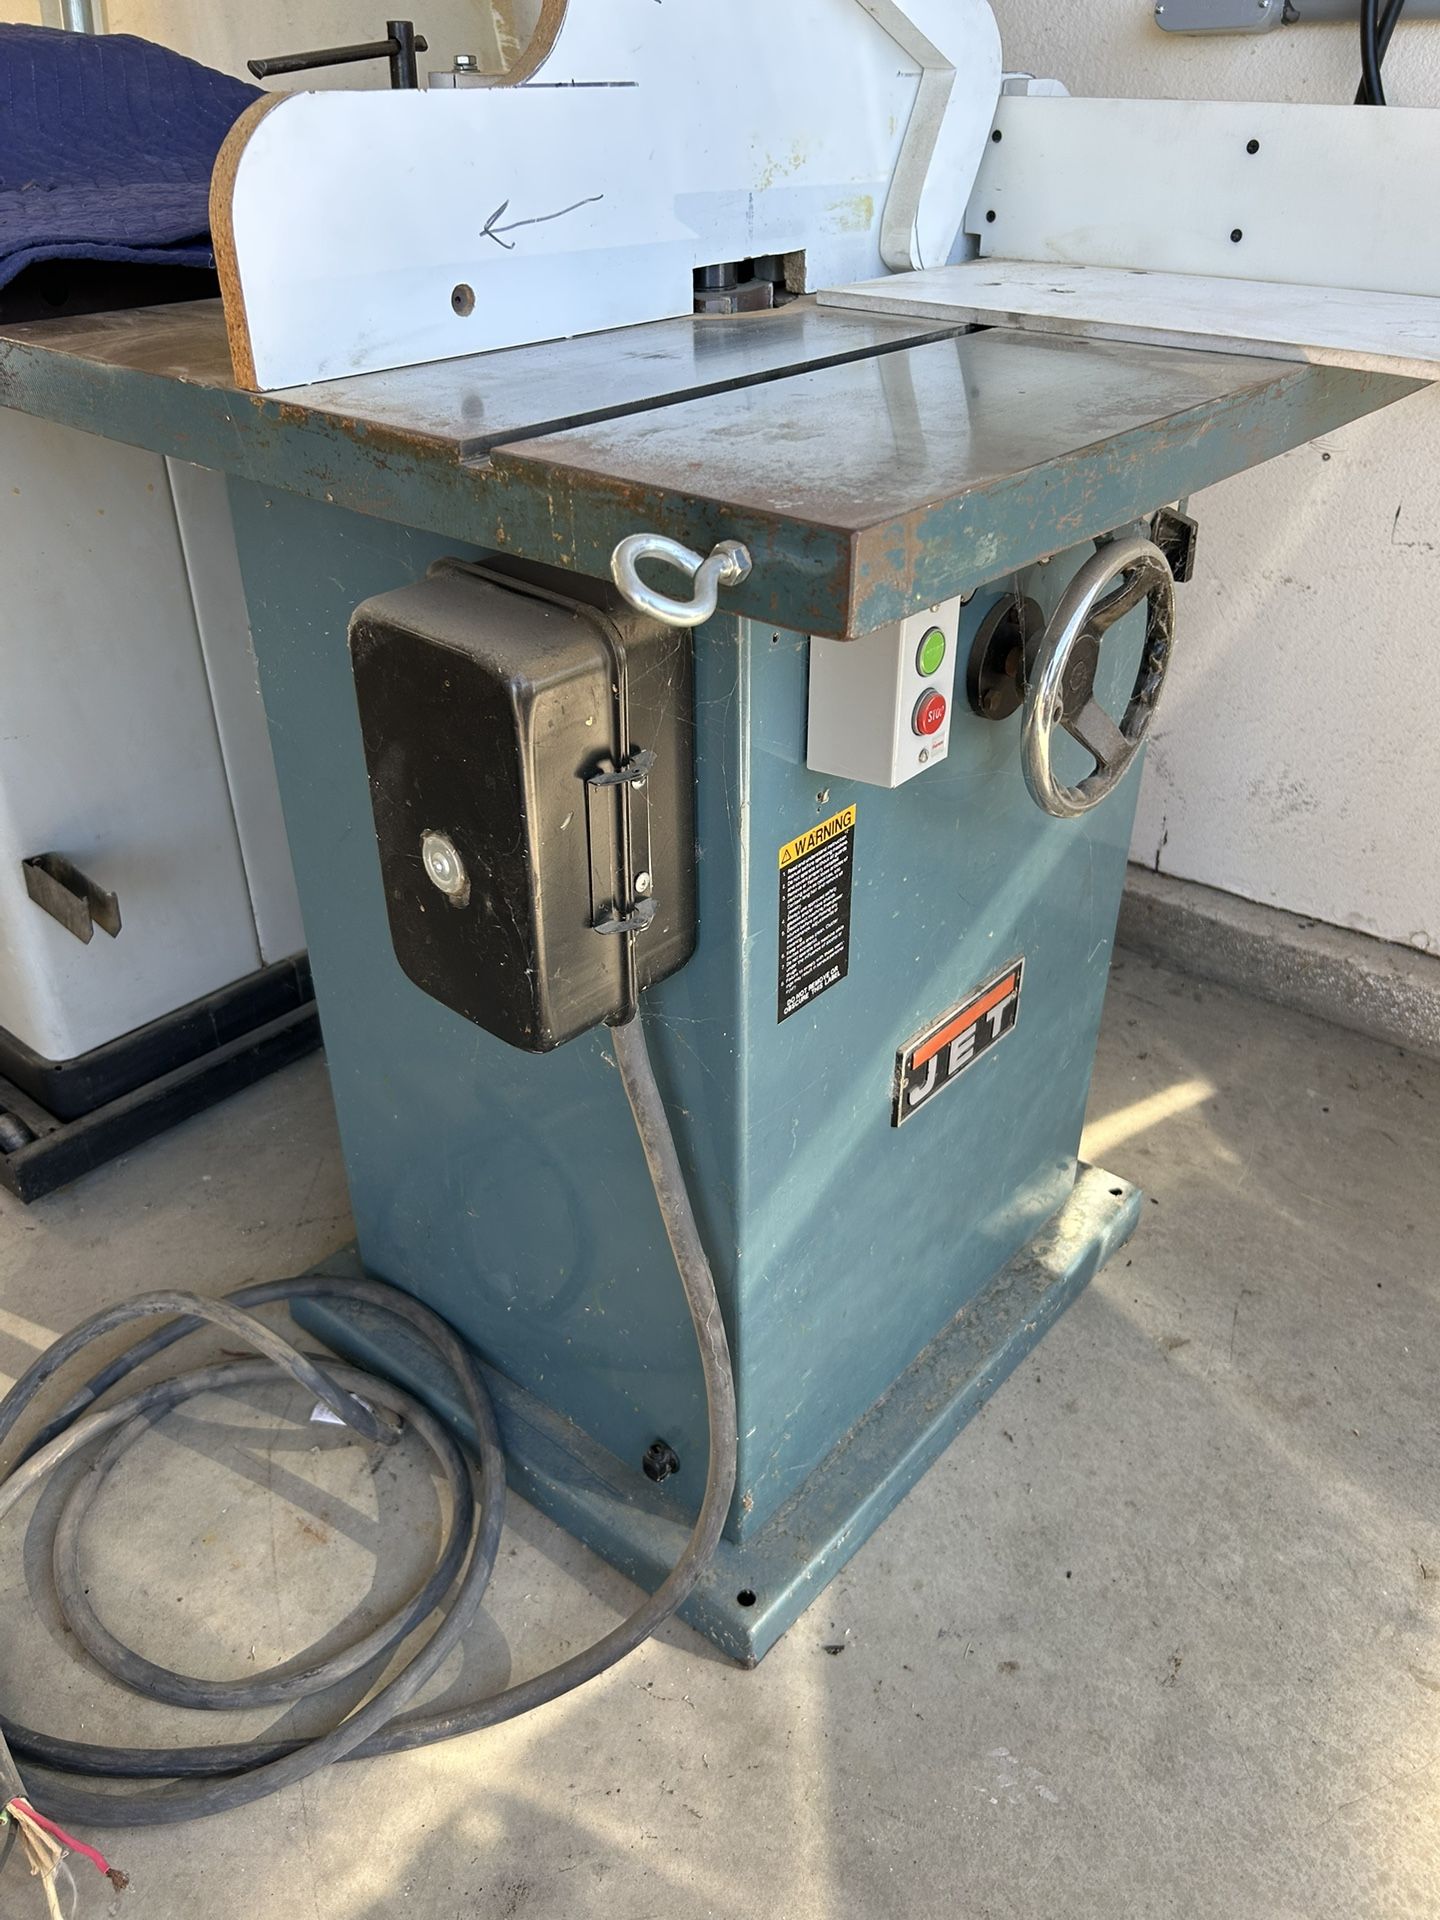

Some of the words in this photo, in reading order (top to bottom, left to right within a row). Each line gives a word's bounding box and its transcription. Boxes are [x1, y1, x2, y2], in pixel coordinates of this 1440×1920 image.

[795, 811, 851, 856] WARNING
[783, 994, 808, 1015] OBSCURE
[811, 983, 823, 995] THIS
[824, 971, 840, 986] LABEL
[786, 996, 795, 1006] DO
[795, 987, 807, 1000] NOT
[808, 970, 829, 991] REMOVE
[830, 965, 838, 975] OR
[909, 997, 1011, 1106] JET
